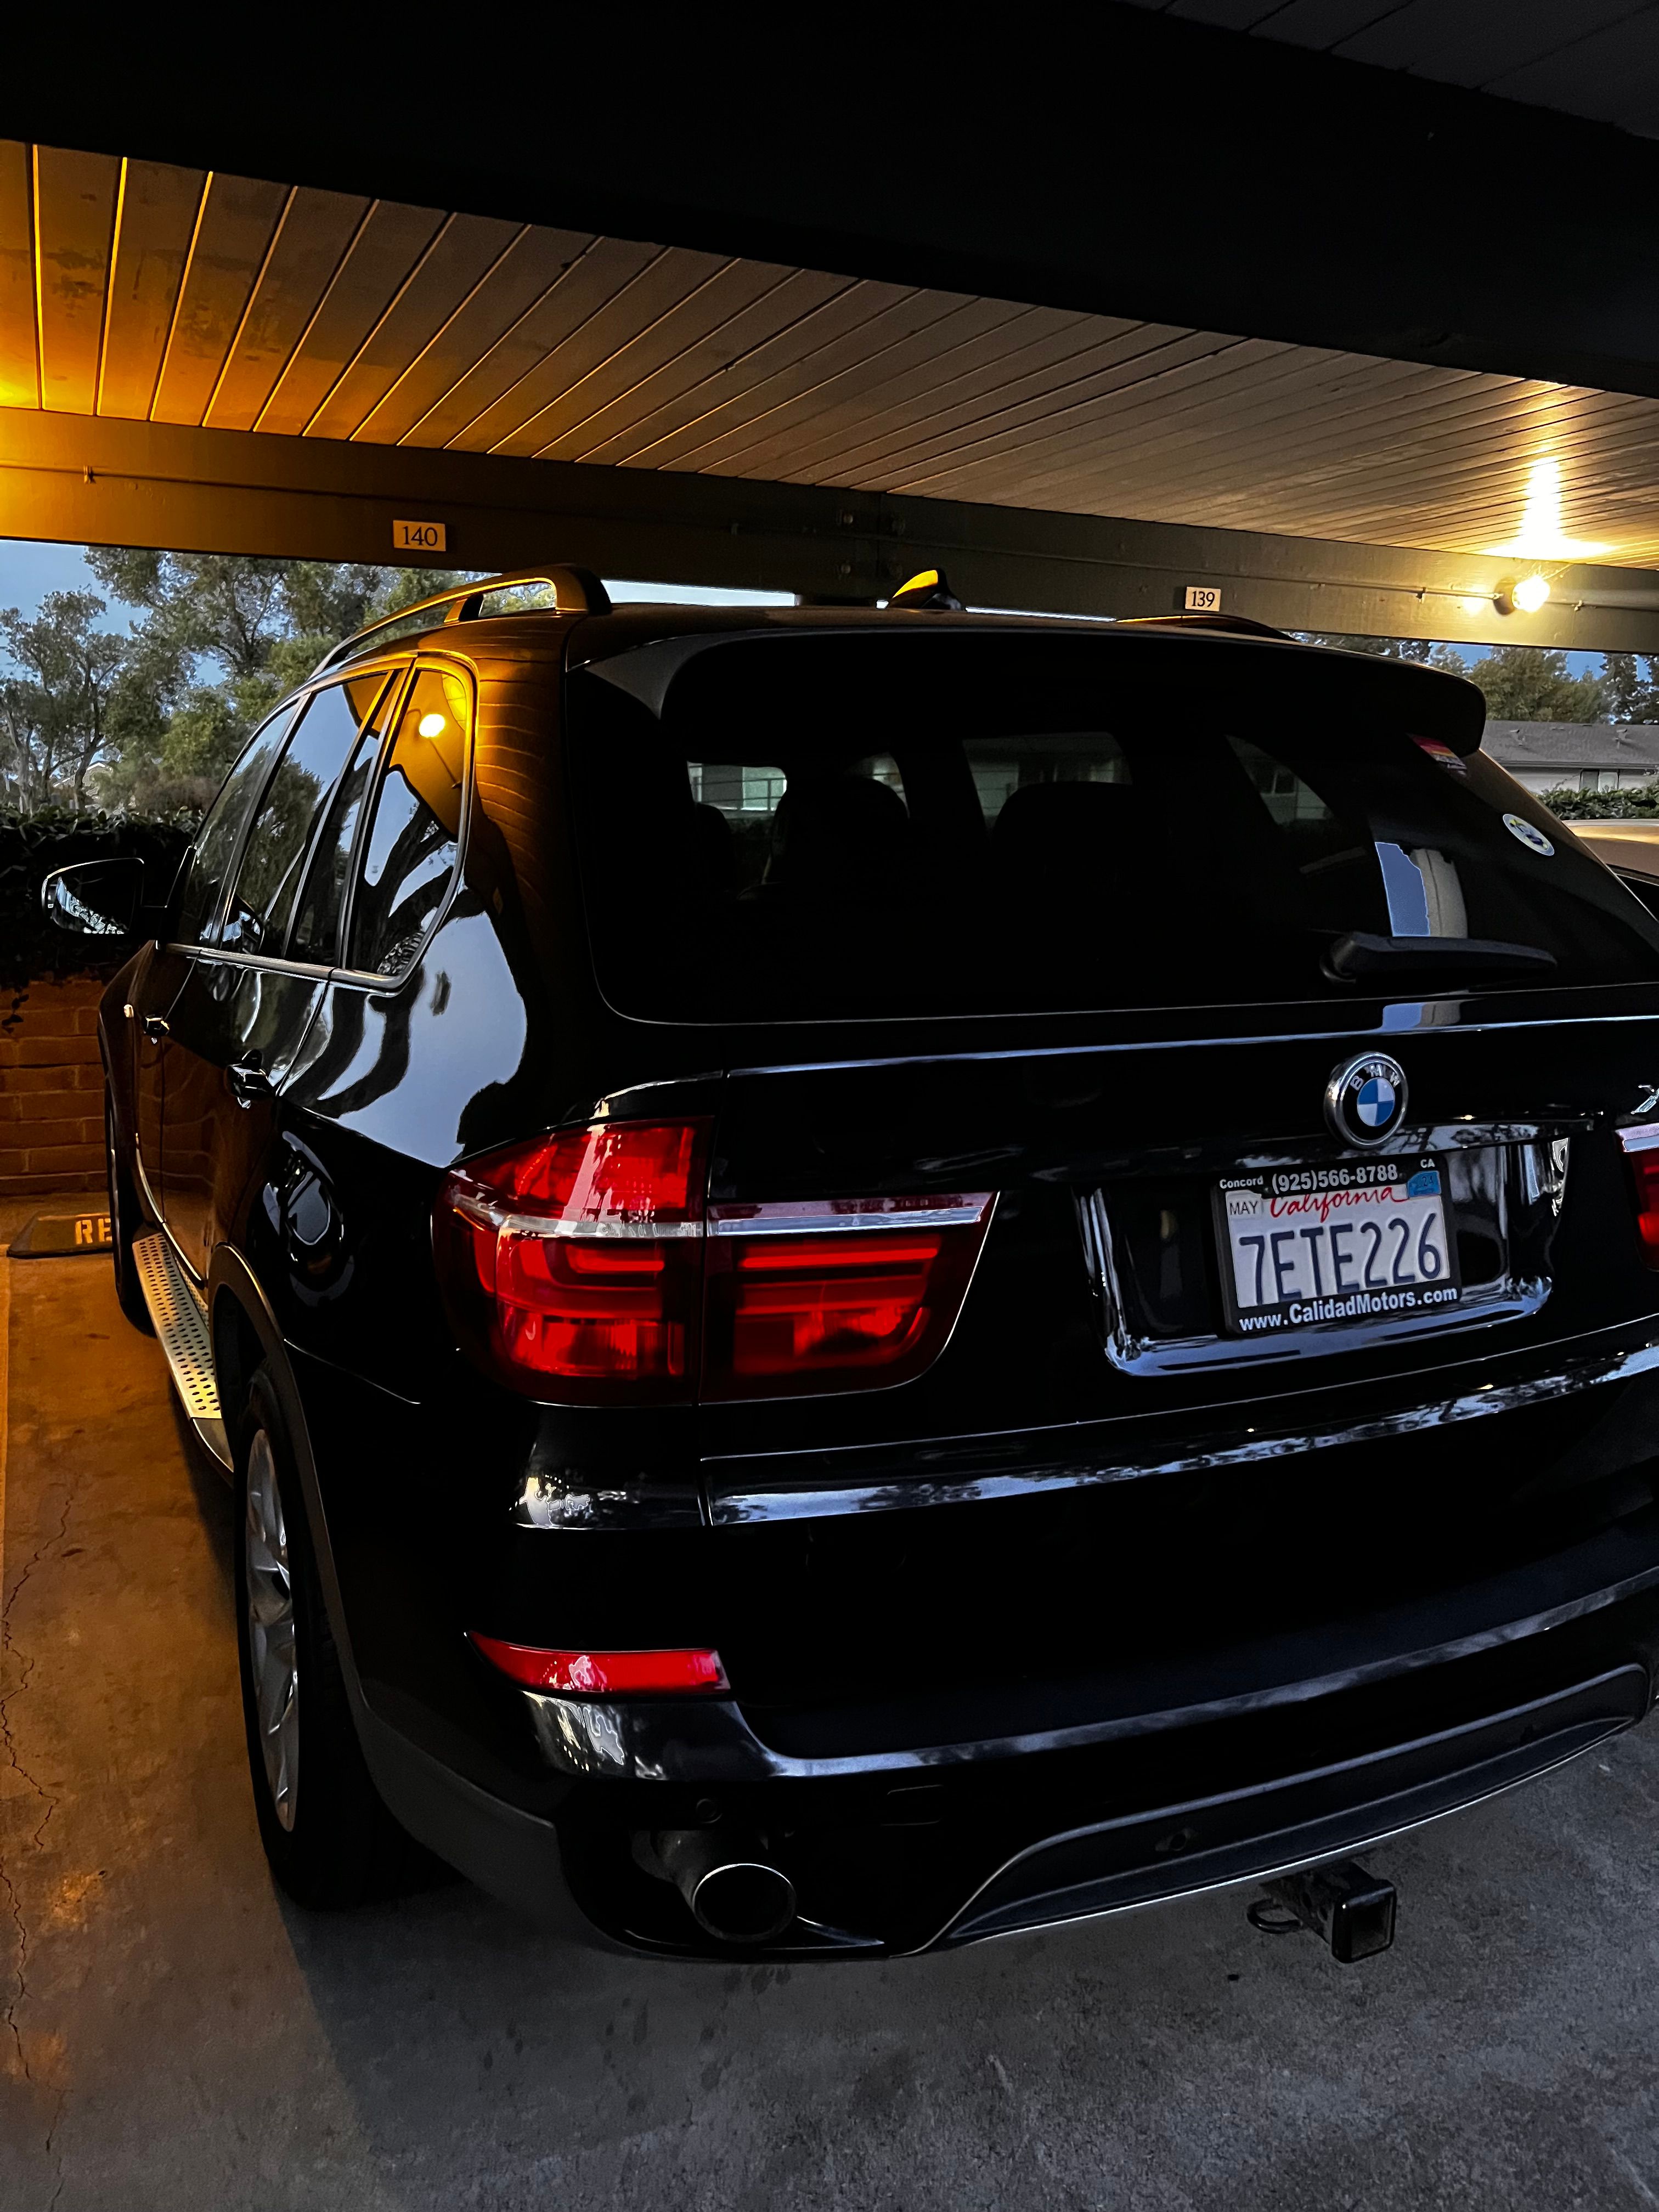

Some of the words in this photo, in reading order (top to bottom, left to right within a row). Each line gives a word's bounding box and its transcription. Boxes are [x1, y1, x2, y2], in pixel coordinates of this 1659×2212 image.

[402, 526, 438, 546] 140
[1192, 590, 1215, 607] 139
[1350, 1064, 1400, 1091] BMW
[1220, 1175, 1263, 1189] Concord
[1272, 1164, 1398, 1194] (925)566-8788
[1420, 1159, 1435, 1169] CA
[1229, 1200, 1259, 1216] MAY
[1269, 1186, 1409, 1223] California
[1239, 1212, 1441, 1306] 7ETE226
[1239, 1286, 1458, 1331] www.CalidadMotors.com
